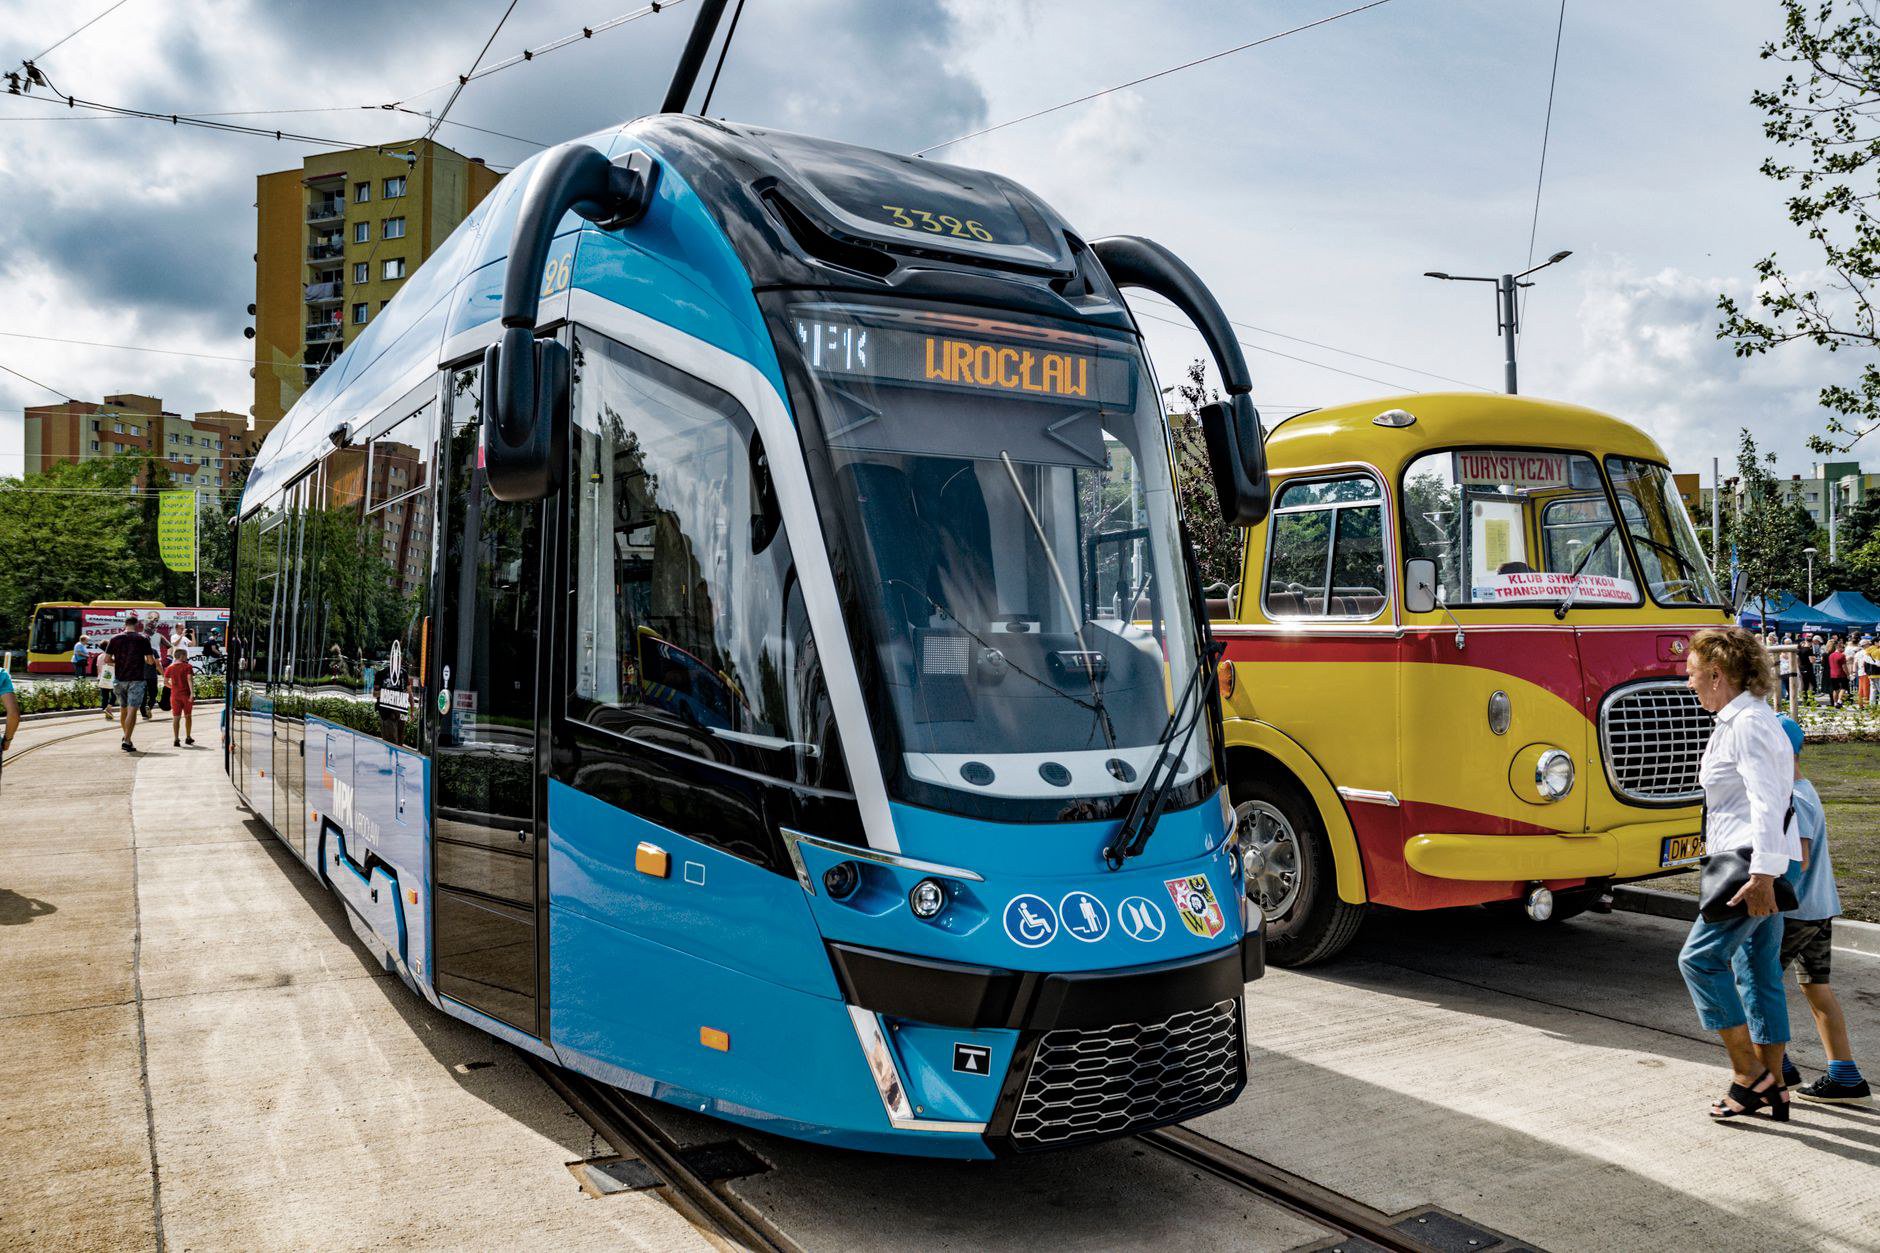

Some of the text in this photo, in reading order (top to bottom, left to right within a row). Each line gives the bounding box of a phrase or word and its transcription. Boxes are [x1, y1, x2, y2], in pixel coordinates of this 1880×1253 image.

[926, 338, 1087, 396] WROCŁAW
[1461, 455, 1563, 481] TURYSTYCZNY
[1508, 574, 1543, 585] KLUB
[332, 777, 354, 829] MPK
[1671, 838, 1688, 859] DW
